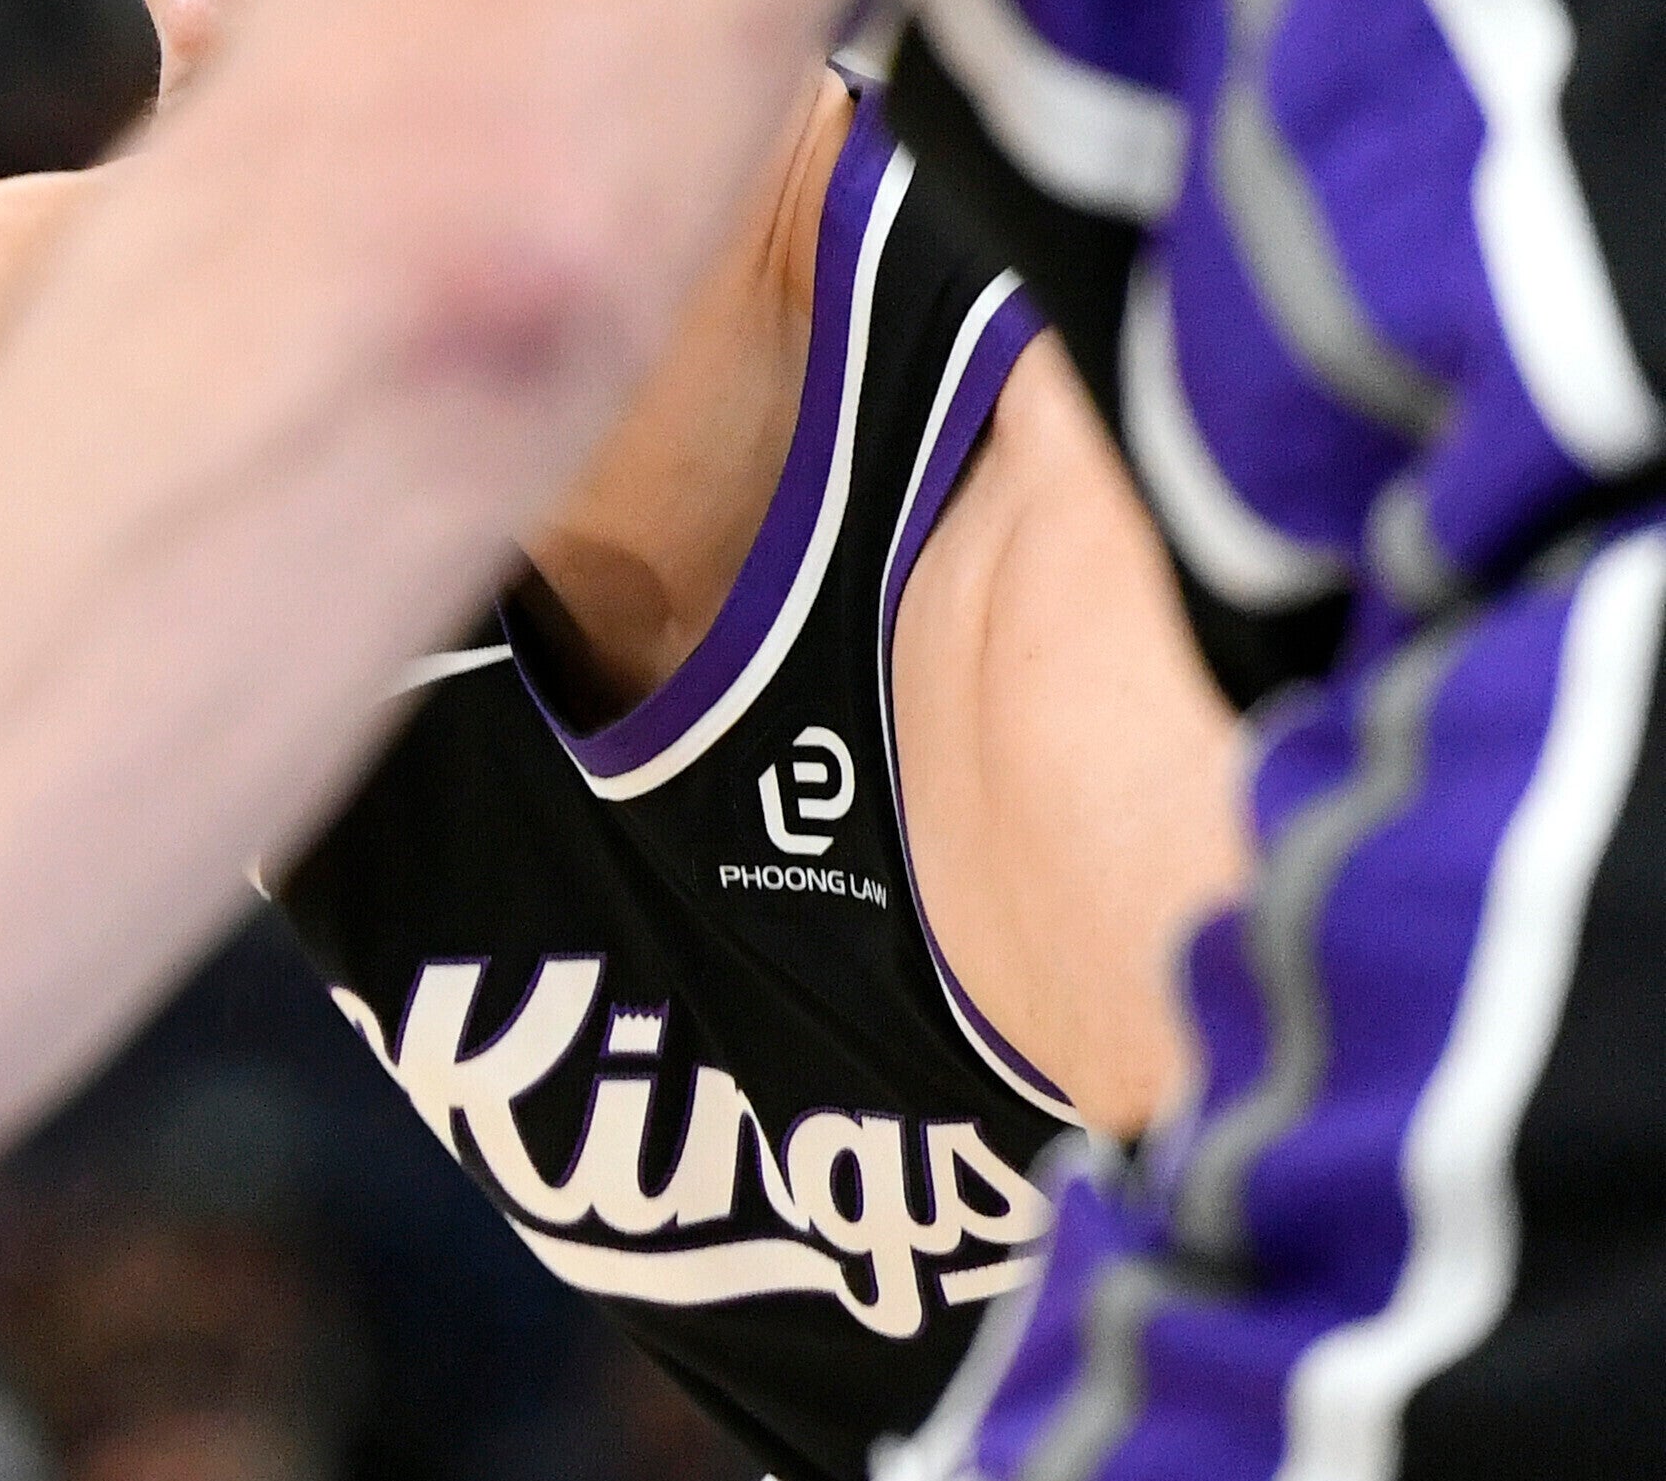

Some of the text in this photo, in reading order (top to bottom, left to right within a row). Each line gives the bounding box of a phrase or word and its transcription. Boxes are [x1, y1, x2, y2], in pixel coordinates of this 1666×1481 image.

[718, 864, 888, 910] PHOONG LAW
[329, 952, 1054, 1338] Kings
